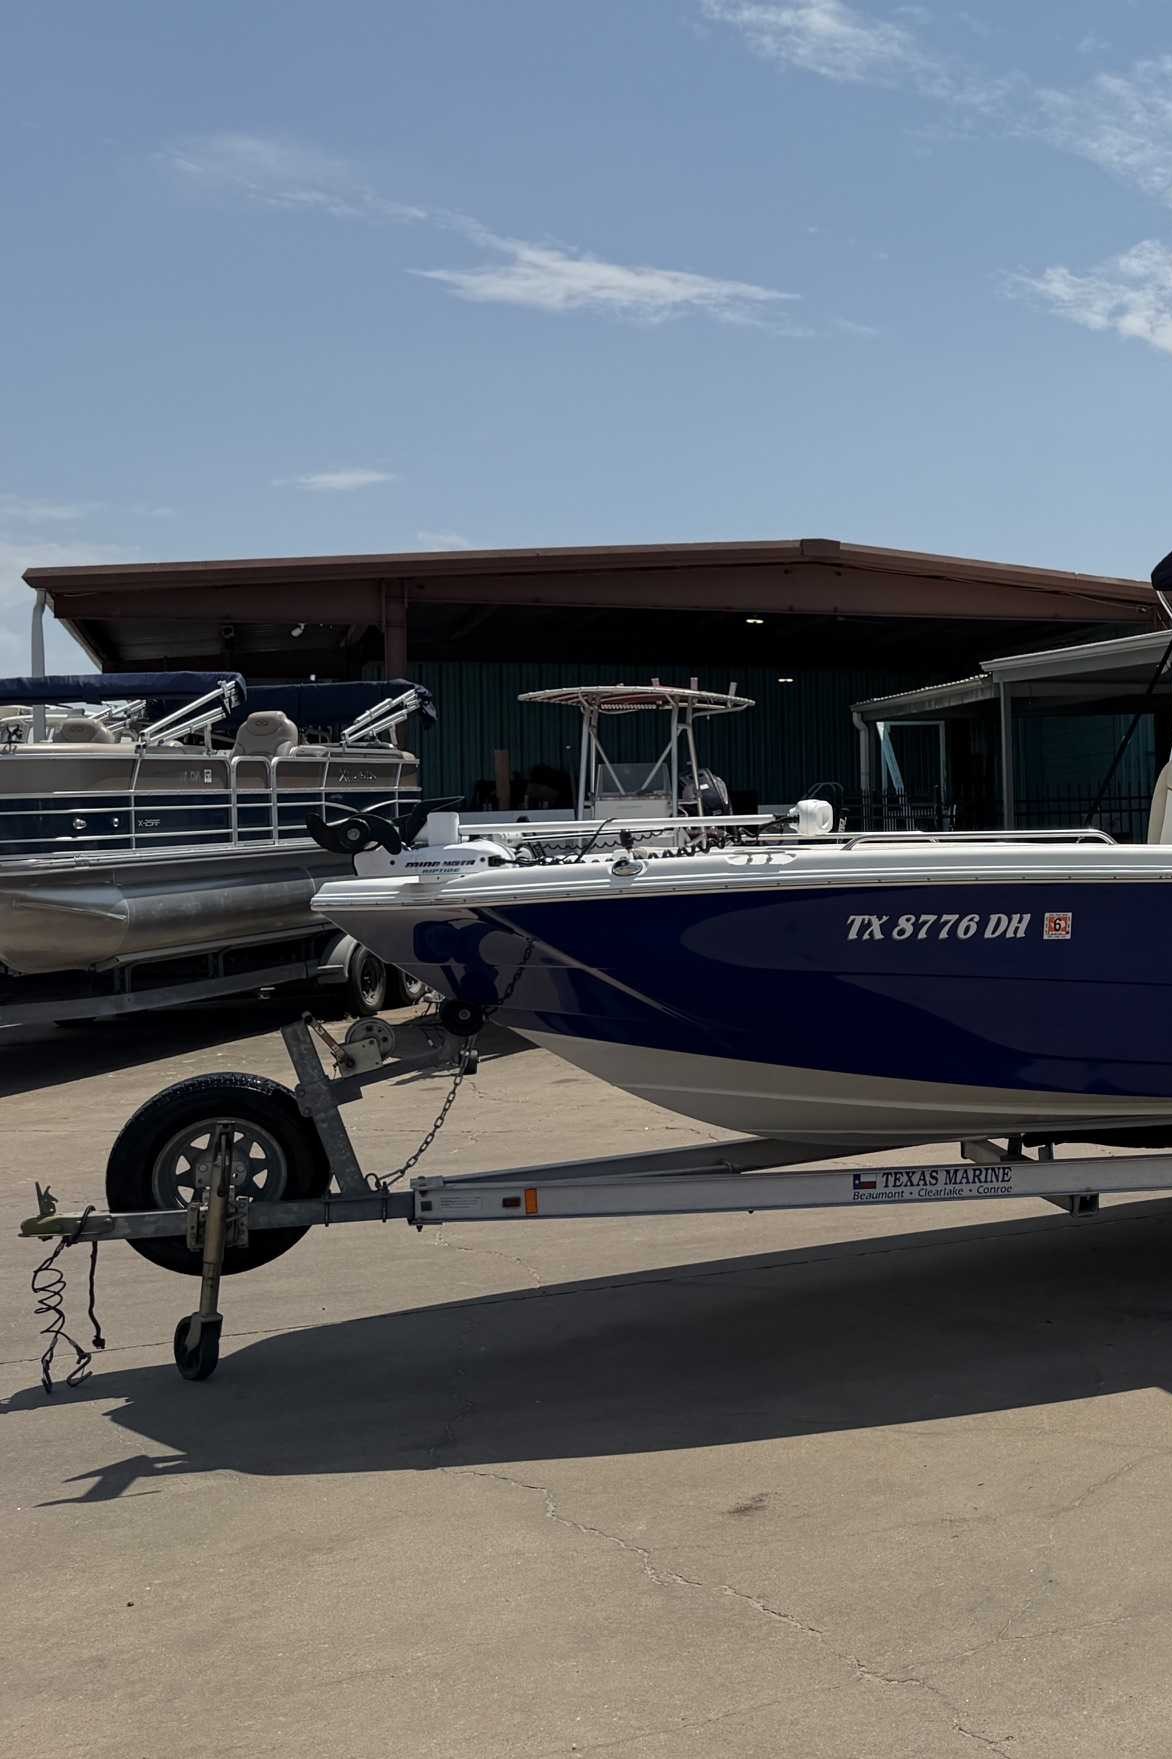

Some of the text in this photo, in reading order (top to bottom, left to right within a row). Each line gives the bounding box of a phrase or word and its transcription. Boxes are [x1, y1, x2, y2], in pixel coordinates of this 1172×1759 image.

[847, 912, 1032, 941] TX 8776 DH
[882, 1166, 1013, 1188] TEXAS MARINE
[853, 1184, 1013, 1200] Beaumont Clearlake Conroe
